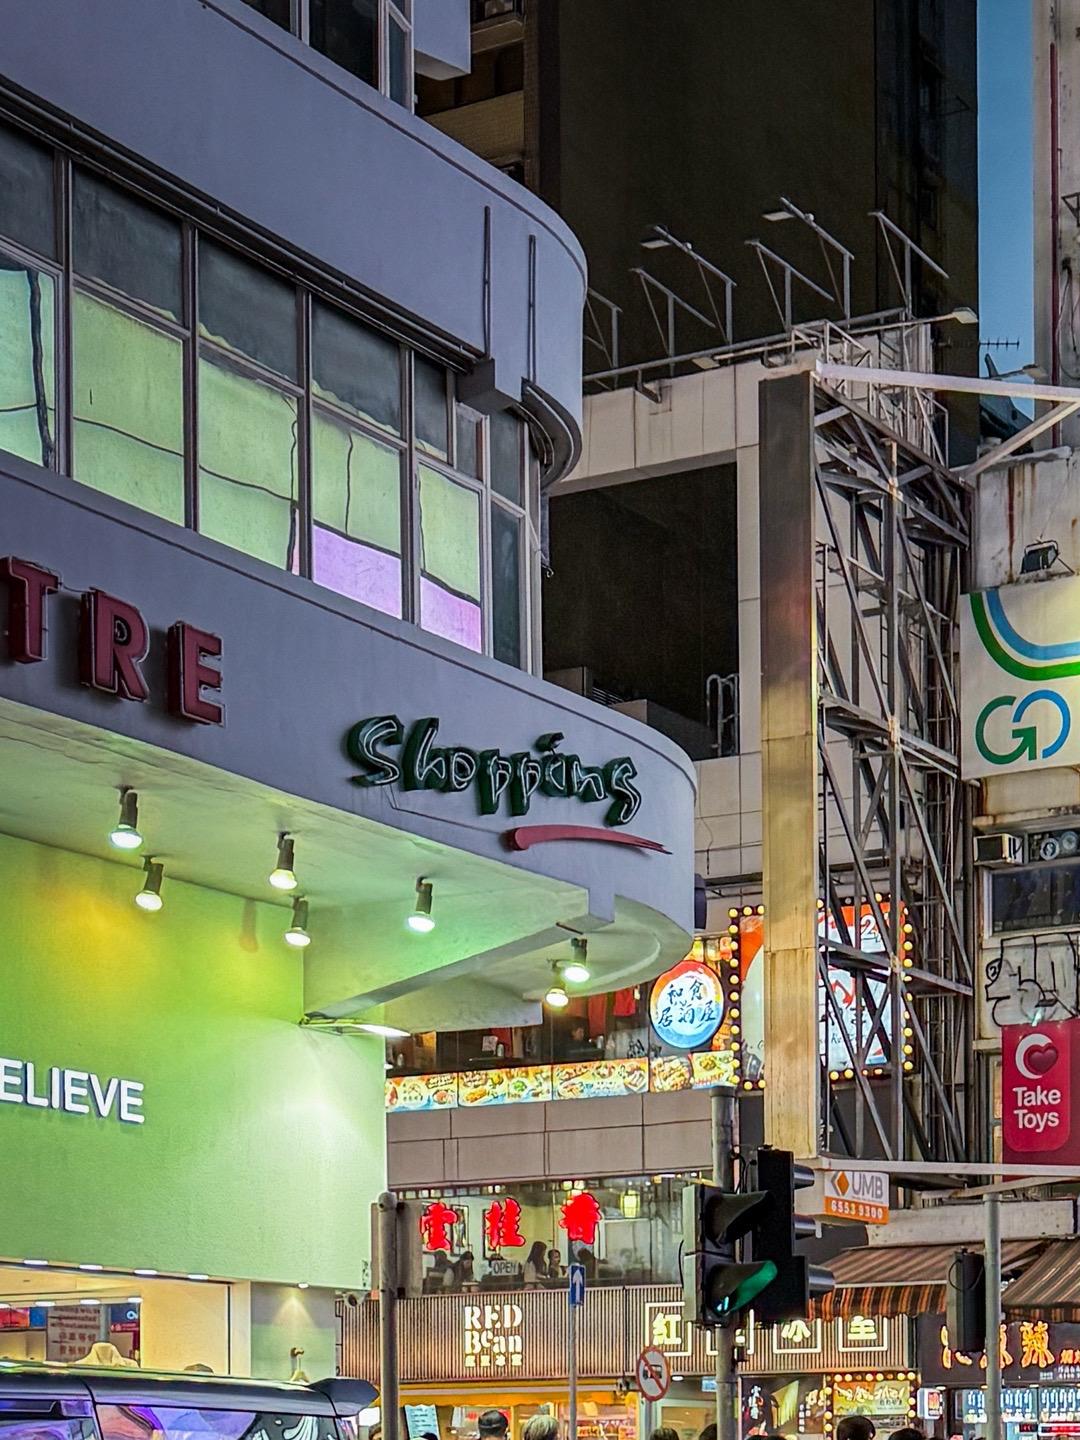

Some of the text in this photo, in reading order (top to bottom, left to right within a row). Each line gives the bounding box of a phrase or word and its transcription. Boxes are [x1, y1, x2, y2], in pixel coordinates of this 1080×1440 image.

[2, 555, 225, 726] TRE
[347, 714, 642, 826] Shopping
[0, 1056, 146, 1124] ELIEVE
[1012, 1085, 1061, 1106] Take
[1013, 1109, 1060, 1132] Toys
[852, 1171, 884, 1199] UMB
[493, 1262, 517, 1275] OPEN
[464, 1303, 523, 1330] RED
[464, 1330, 523, 1354] Bean
